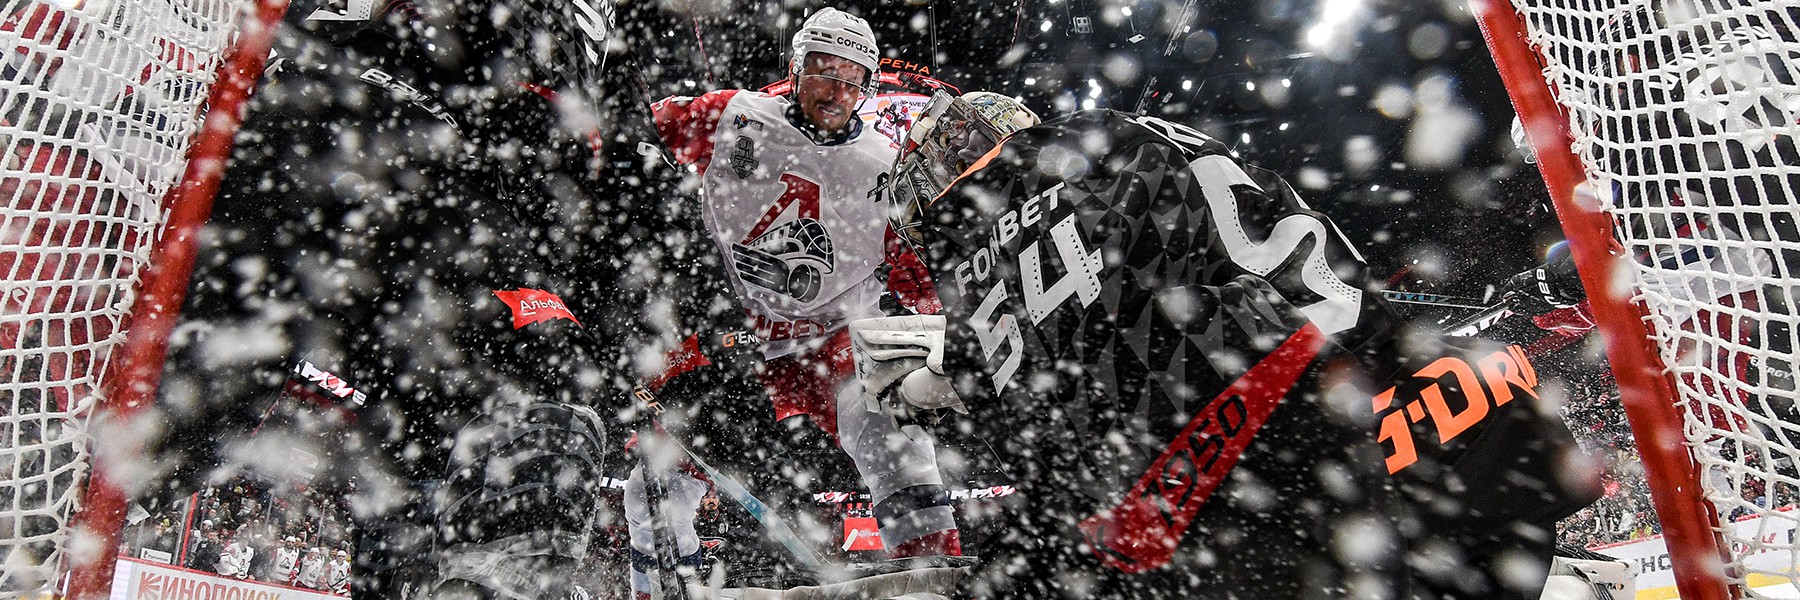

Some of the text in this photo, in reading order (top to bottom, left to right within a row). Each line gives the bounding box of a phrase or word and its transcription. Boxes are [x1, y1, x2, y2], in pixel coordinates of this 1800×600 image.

[954, 181, 1066, 297] FONBET
[1536, 268, 1576, 309] BAU
[969, 212, 1104, 398] 54
[1139, 394, 1248, 529] 1950
[137, 571, 281, 600] КИНОПОИ
